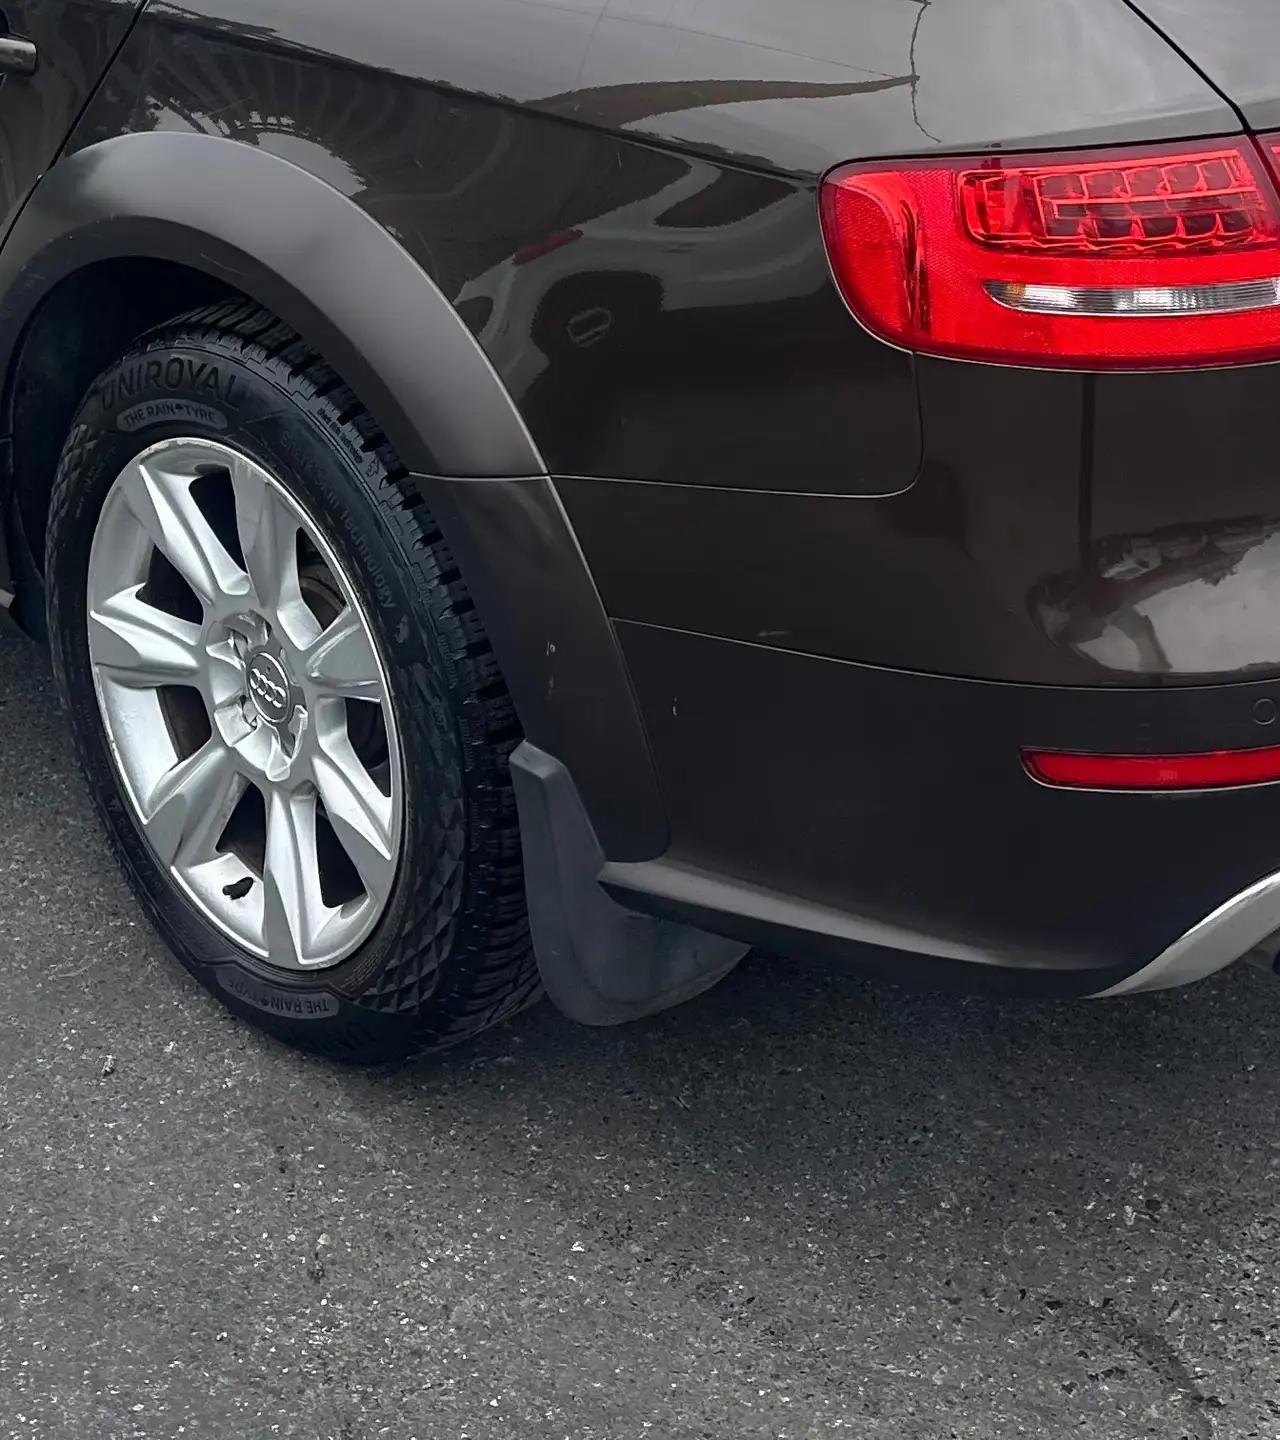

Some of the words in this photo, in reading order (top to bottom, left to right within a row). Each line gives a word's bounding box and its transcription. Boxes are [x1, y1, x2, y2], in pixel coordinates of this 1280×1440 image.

[101, 357, 239, 411] UNIROYAL
[124, 409, 147, 428] THE
[148, 404, 175, 418] RAIN
[183, 405, 217, 424] TYRE
[340, 510, 397, 609] Technology
